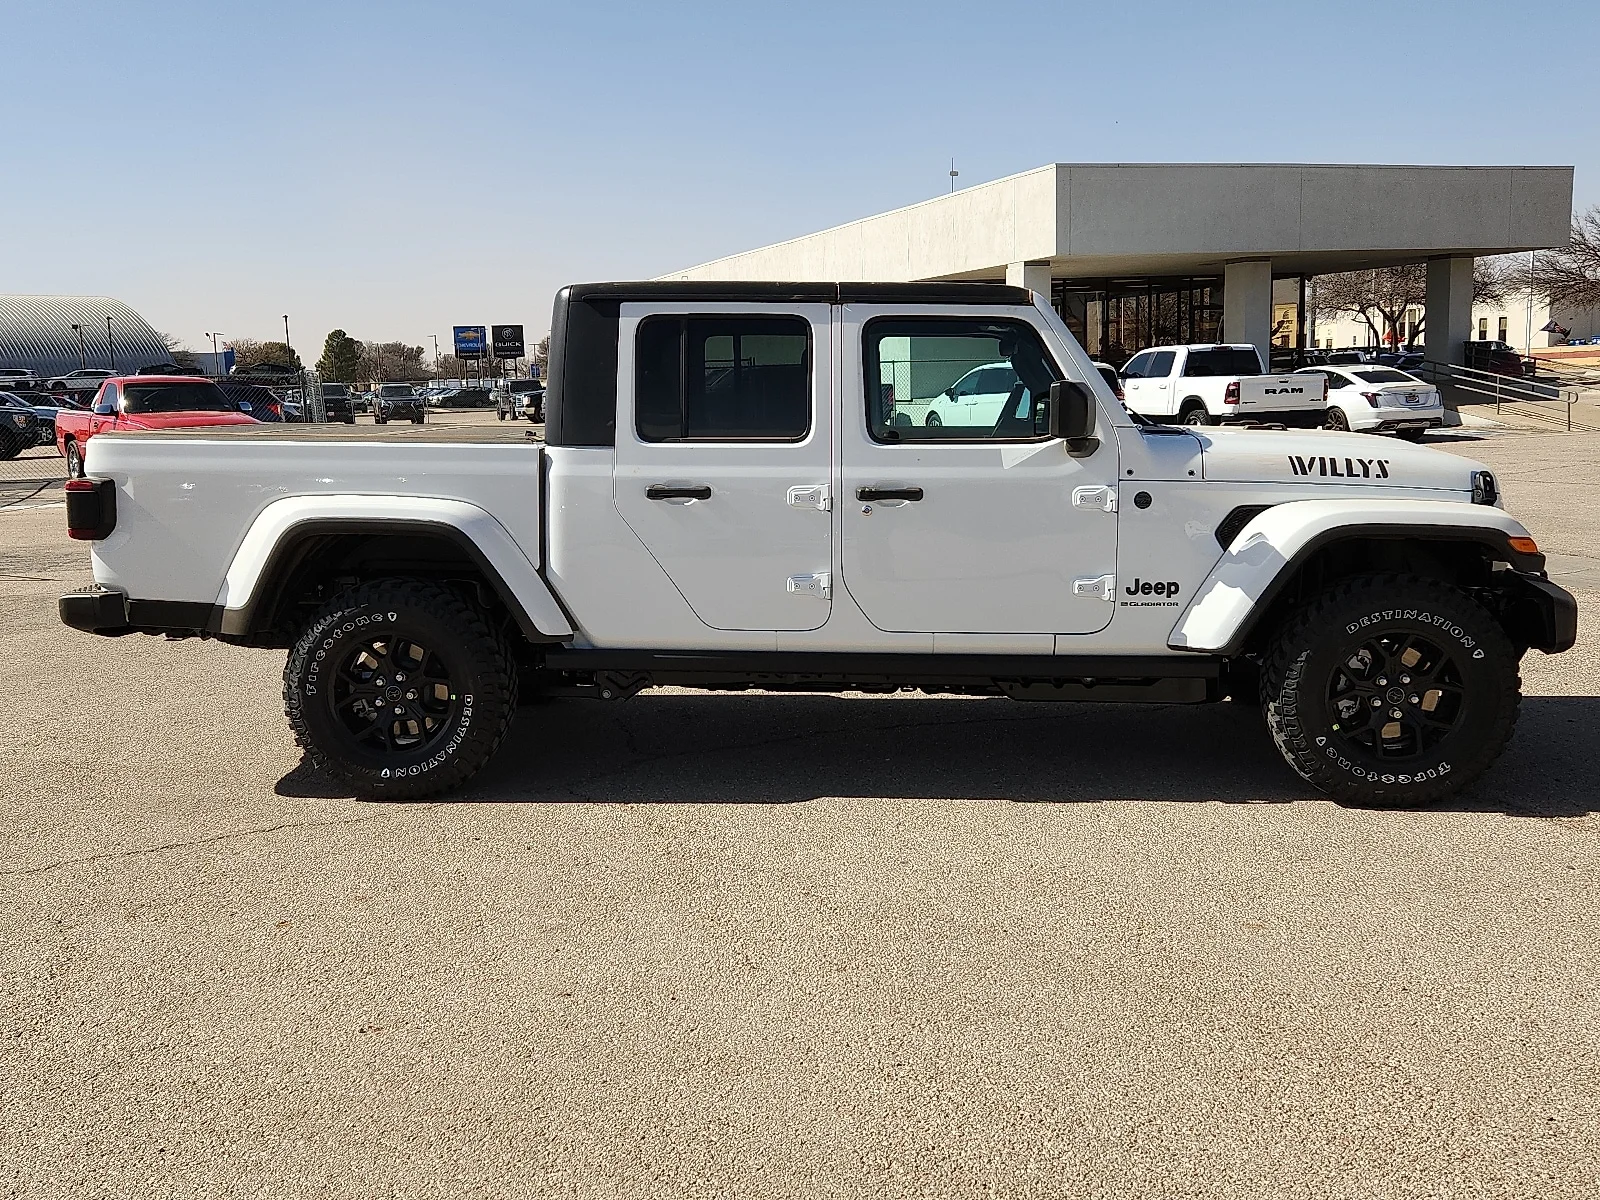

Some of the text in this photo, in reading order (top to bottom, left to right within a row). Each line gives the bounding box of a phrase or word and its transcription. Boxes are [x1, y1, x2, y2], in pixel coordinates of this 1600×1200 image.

[1264, 387, 1304, 395] RAM
[1287, 455, 1390, 479] WILLYS
[1125, 578, 1180, 598] Jeep
[1346, 609, 1476, 648] DESTINATION
[305, 613, 384, 696] Firestone
[394, 694, 474, 778] DESTINATION
[1326, 746, 1451, 784] Firestone
